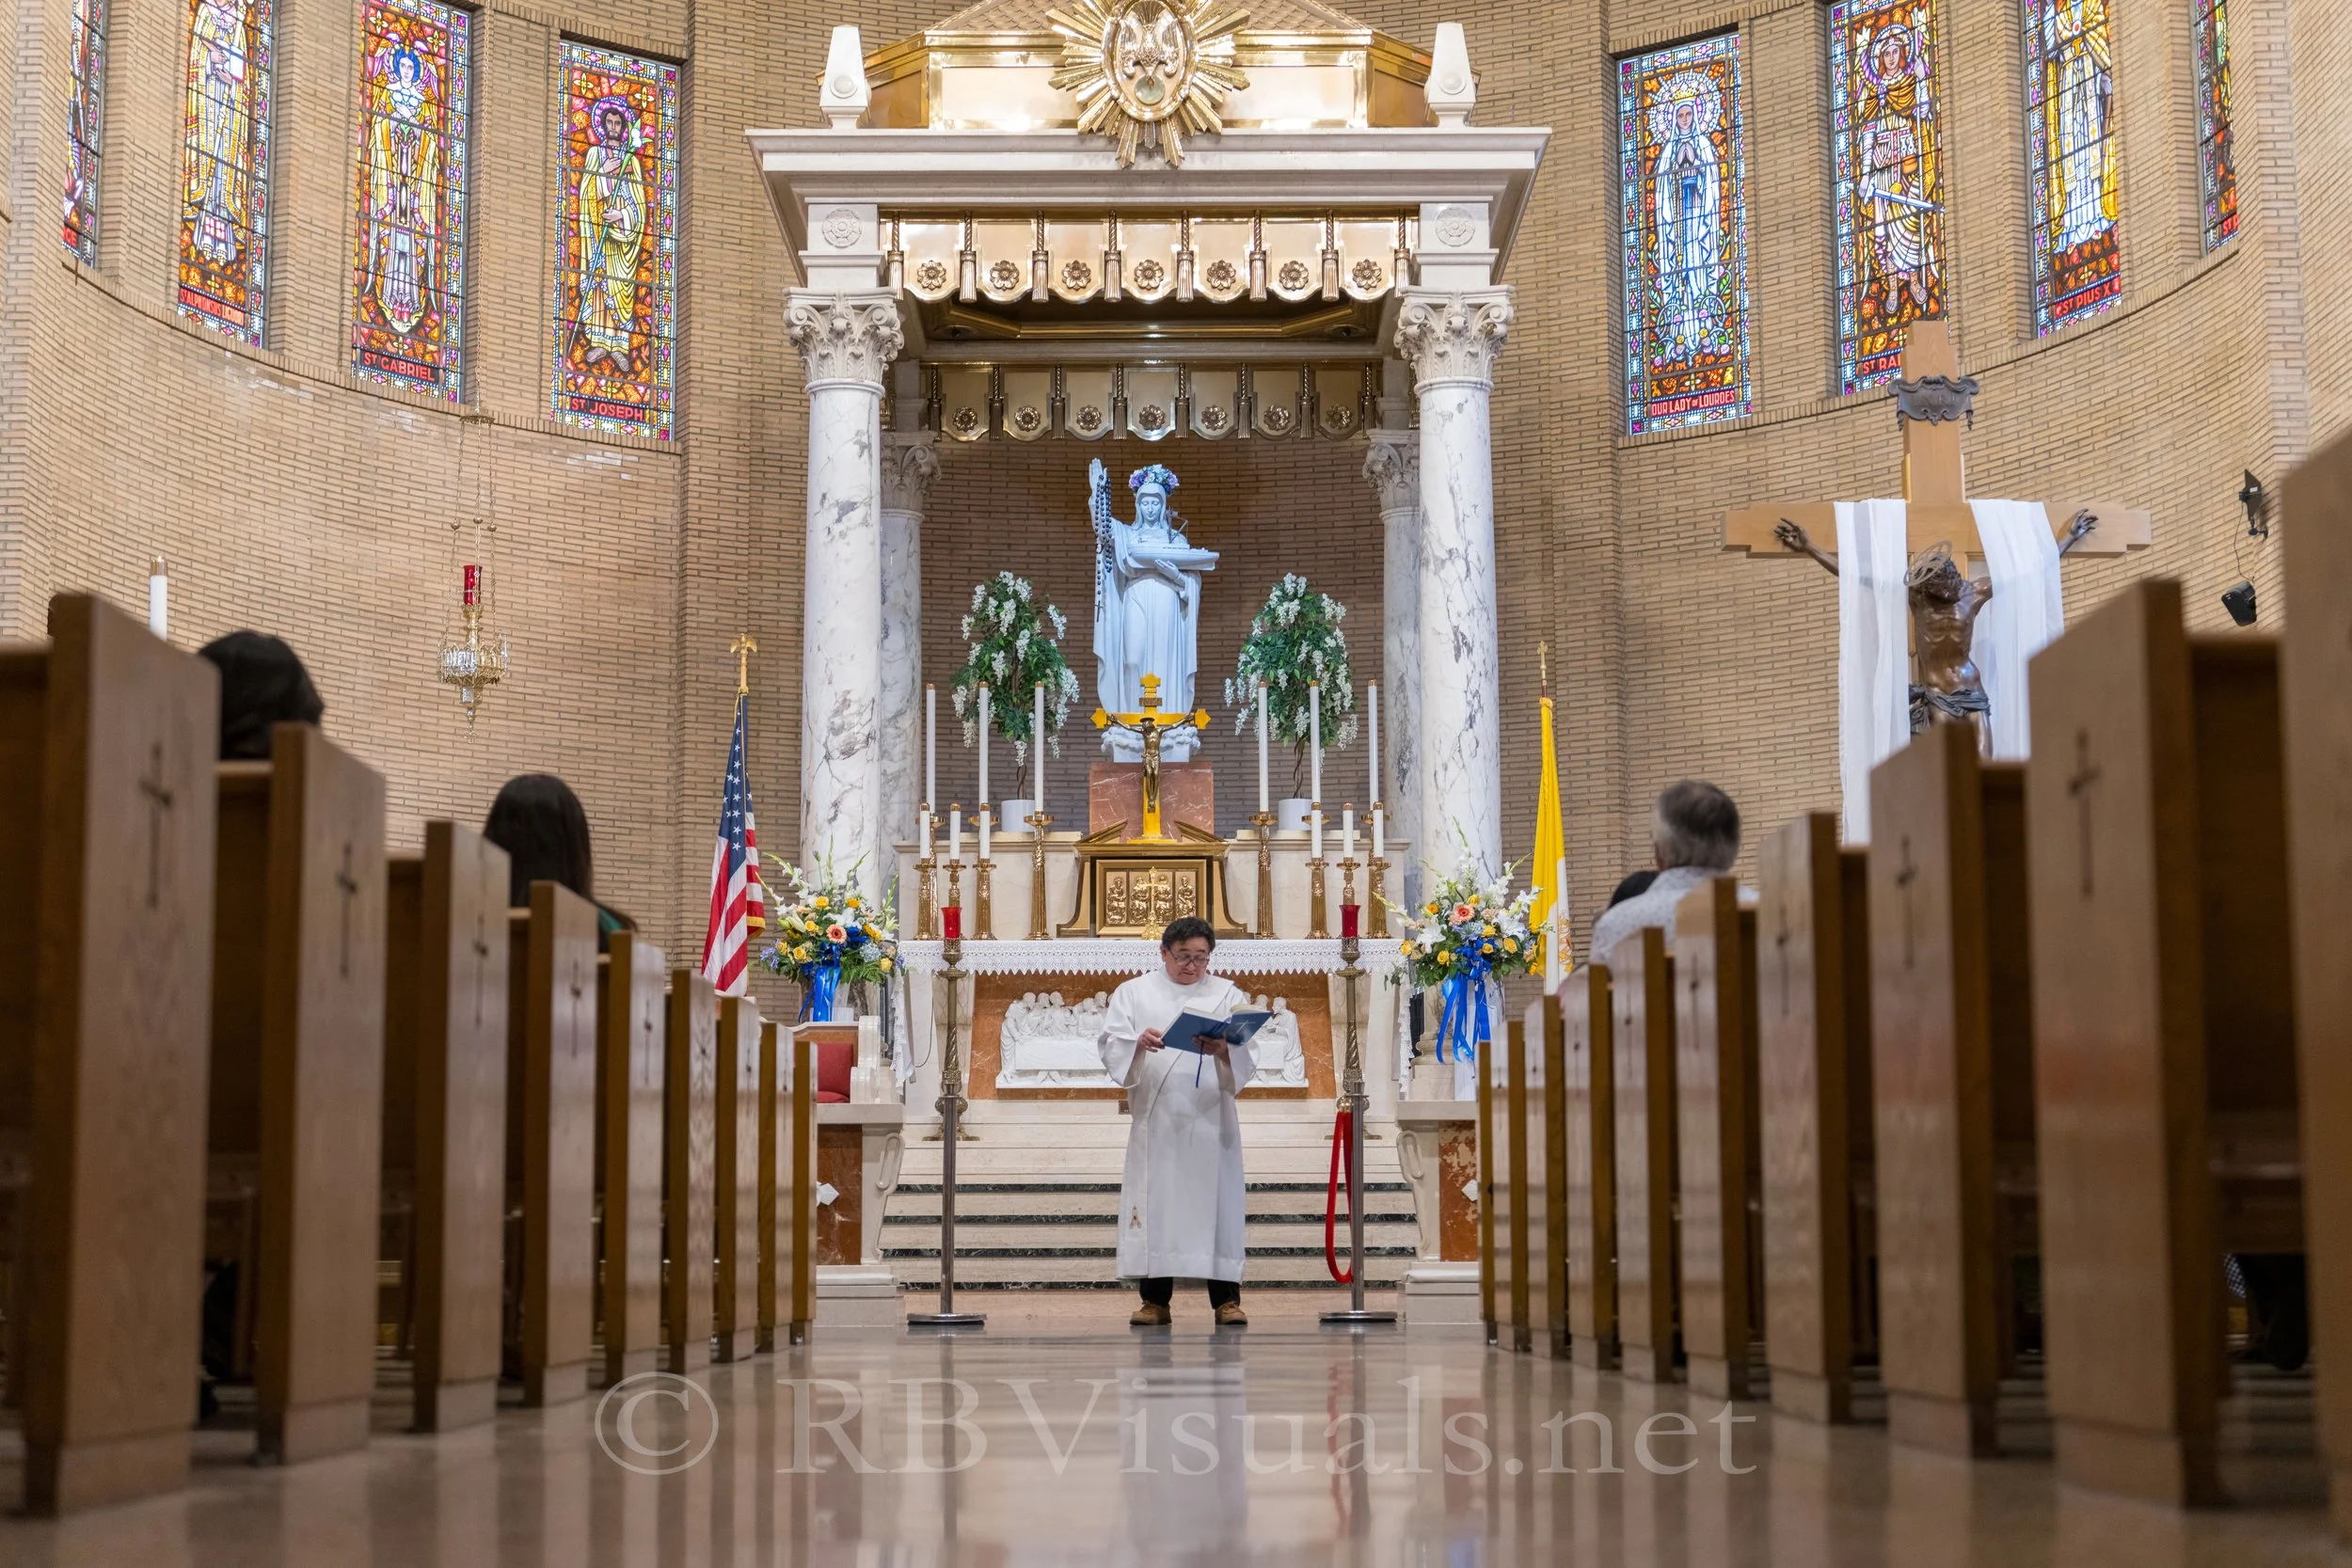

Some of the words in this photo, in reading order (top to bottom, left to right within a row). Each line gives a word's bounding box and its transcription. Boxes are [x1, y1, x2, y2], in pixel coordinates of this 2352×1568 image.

[2076, 286, 2101, 309] PIUS
[2104, 281, 2112, 297] X
[380, 356, 436, 381] GABRIEL
[590, 403, 645, 421] JOSEPH
[1652, 402, 1668, 417] OUR
[1669, 397, 1692, 416] LADY
[1699, 389, 1735, 408] LOURDES
